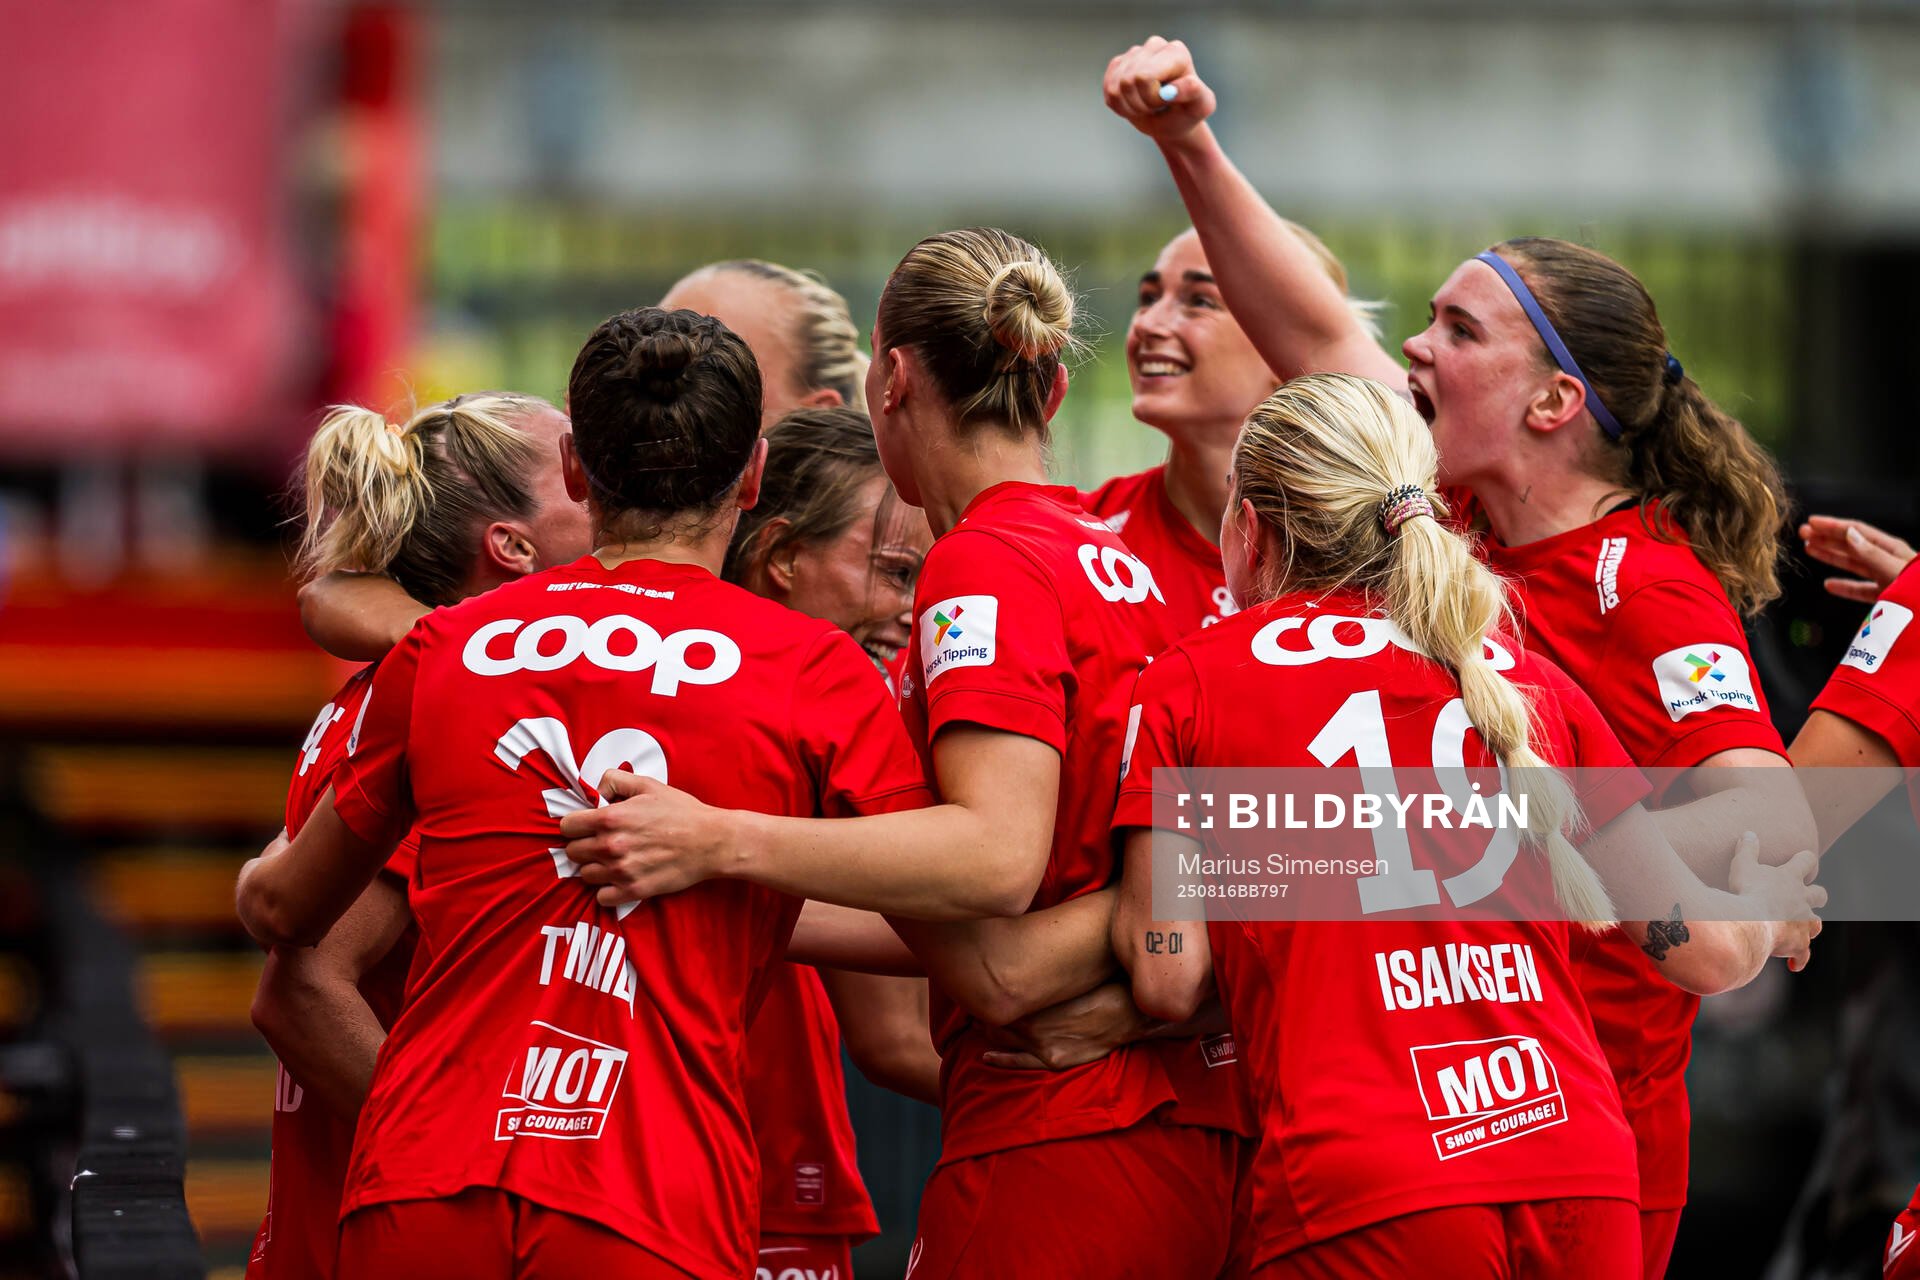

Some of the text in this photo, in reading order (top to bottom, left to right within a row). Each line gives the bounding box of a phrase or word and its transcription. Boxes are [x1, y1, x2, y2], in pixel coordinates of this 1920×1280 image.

[462, 614, 742, 697] coop
[943, 645, 988, 662] Tipping
[1848, 645, 1877, 666] ipping
[1670, 689, 1753, 711] Norsk Tipping
[1374, 942, 1543, 1011] ISAKSEN
[1436, 1038, 1549, 1118] MOT
[525, 1114, 593, 1130] COURAGE!
[1445, 1102, 1557, 1150] SHOW COURAGE!
